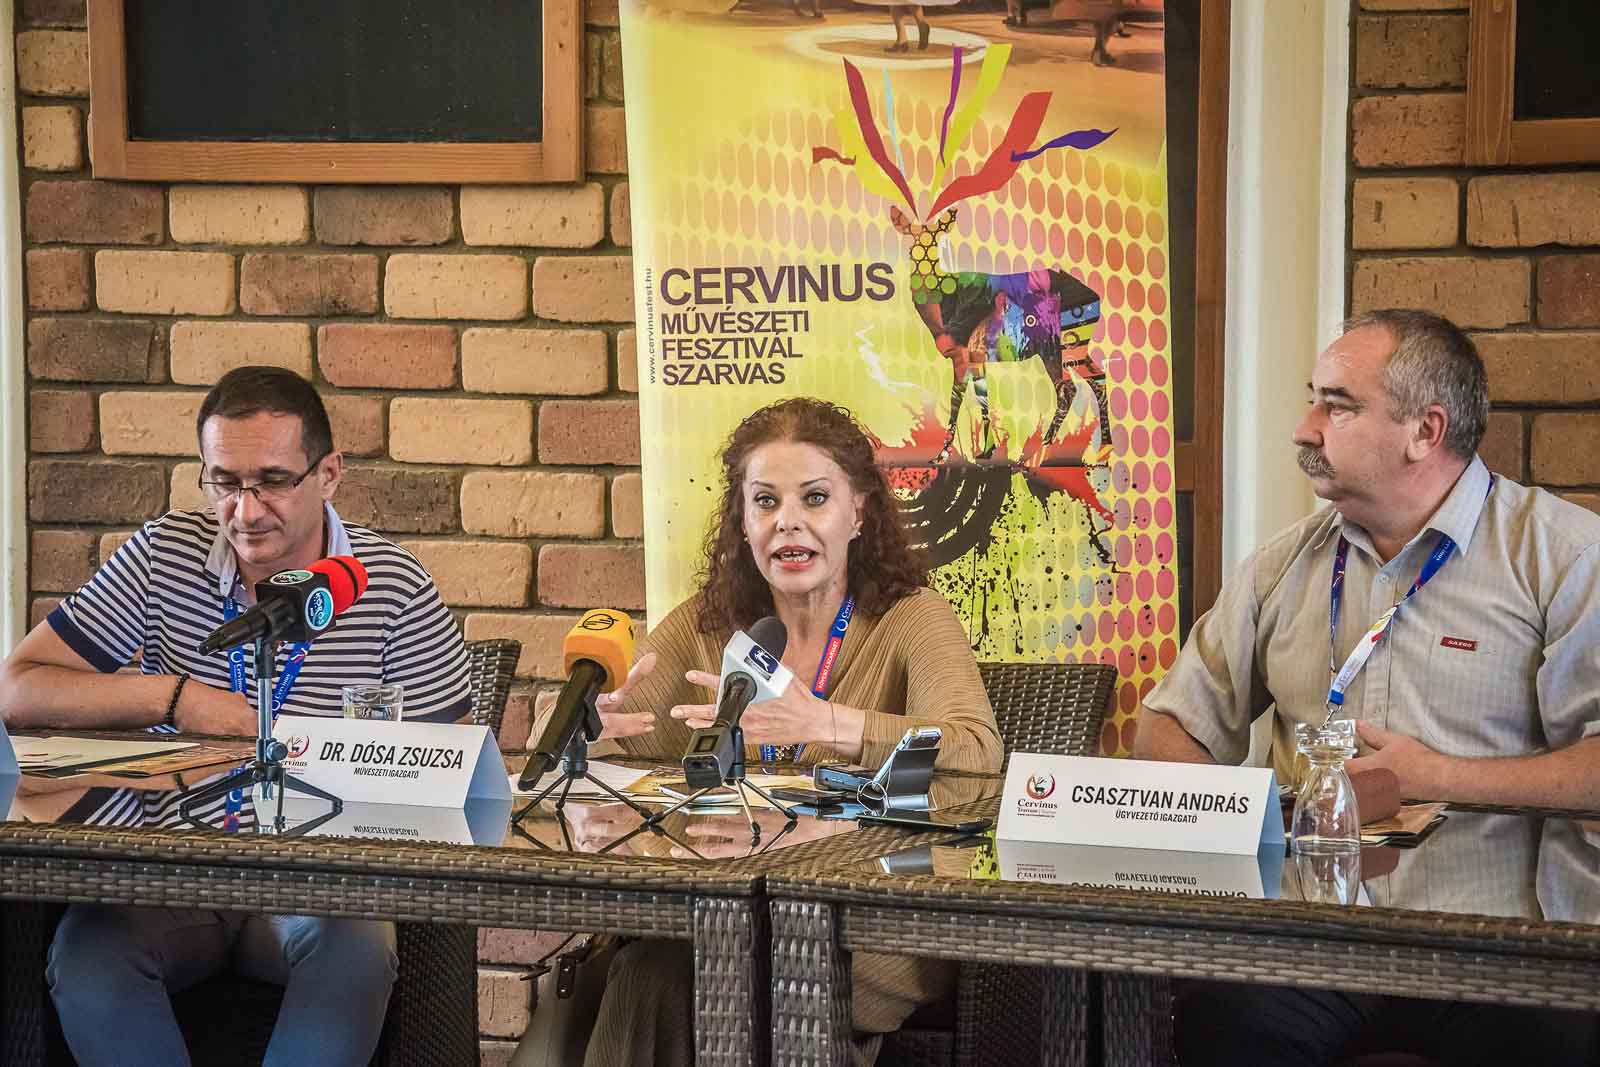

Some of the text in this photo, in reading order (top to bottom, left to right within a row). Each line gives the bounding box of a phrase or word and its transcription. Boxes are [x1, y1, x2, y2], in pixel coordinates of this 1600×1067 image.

[660, 263, 896, 305] CERVINUS
[645, 268, 656, 385] www.cervinusfest.hu
[661, 306, 809, 334] MŰVÉSZETI
[662, 332, 803, 360] FESZTIVÁL
[663, 362, 785, 385] SZARVAS
[319, 740, 464, 769] DR. DÓSA ZSUZSA
[1017, 798, 1058, 810] Cervinus
[1072, 785, 1250, 814] CSASZTVAN ANDRÁS
